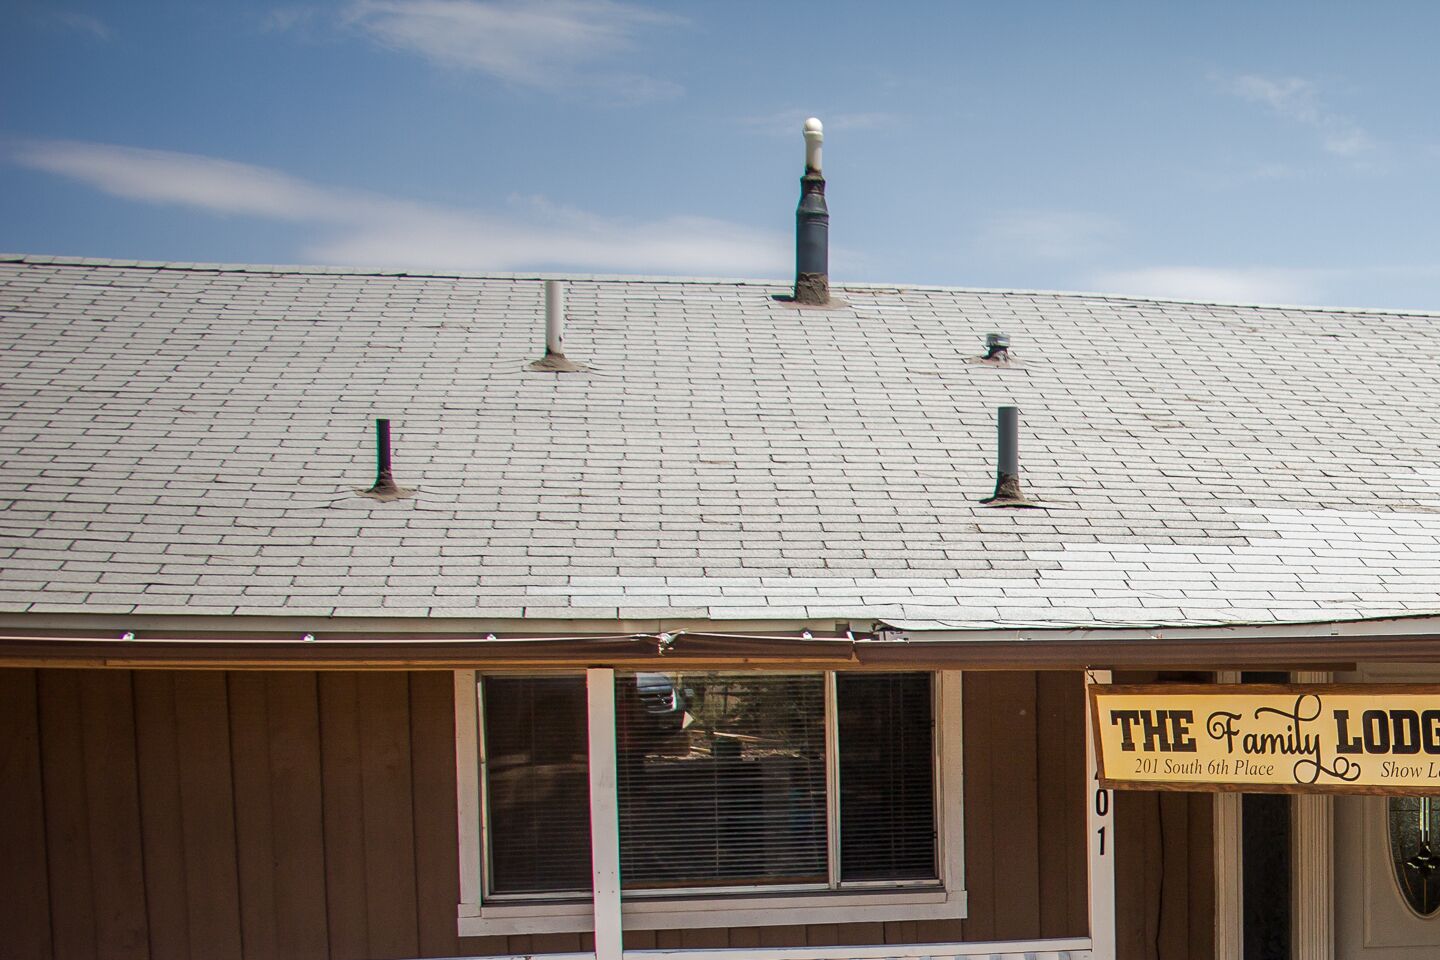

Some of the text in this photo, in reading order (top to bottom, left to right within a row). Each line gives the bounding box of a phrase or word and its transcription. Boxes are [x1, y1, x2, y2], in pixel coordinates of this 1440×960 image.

[1110, 709, 1197, 753] THE
[1206, 694, 1361, 784] Family
[1134, 758, 1275, 777] 201 South 6th Place
[1380, 761, 1423, 779] Show
[1094, 770, 1109, 856] 01
